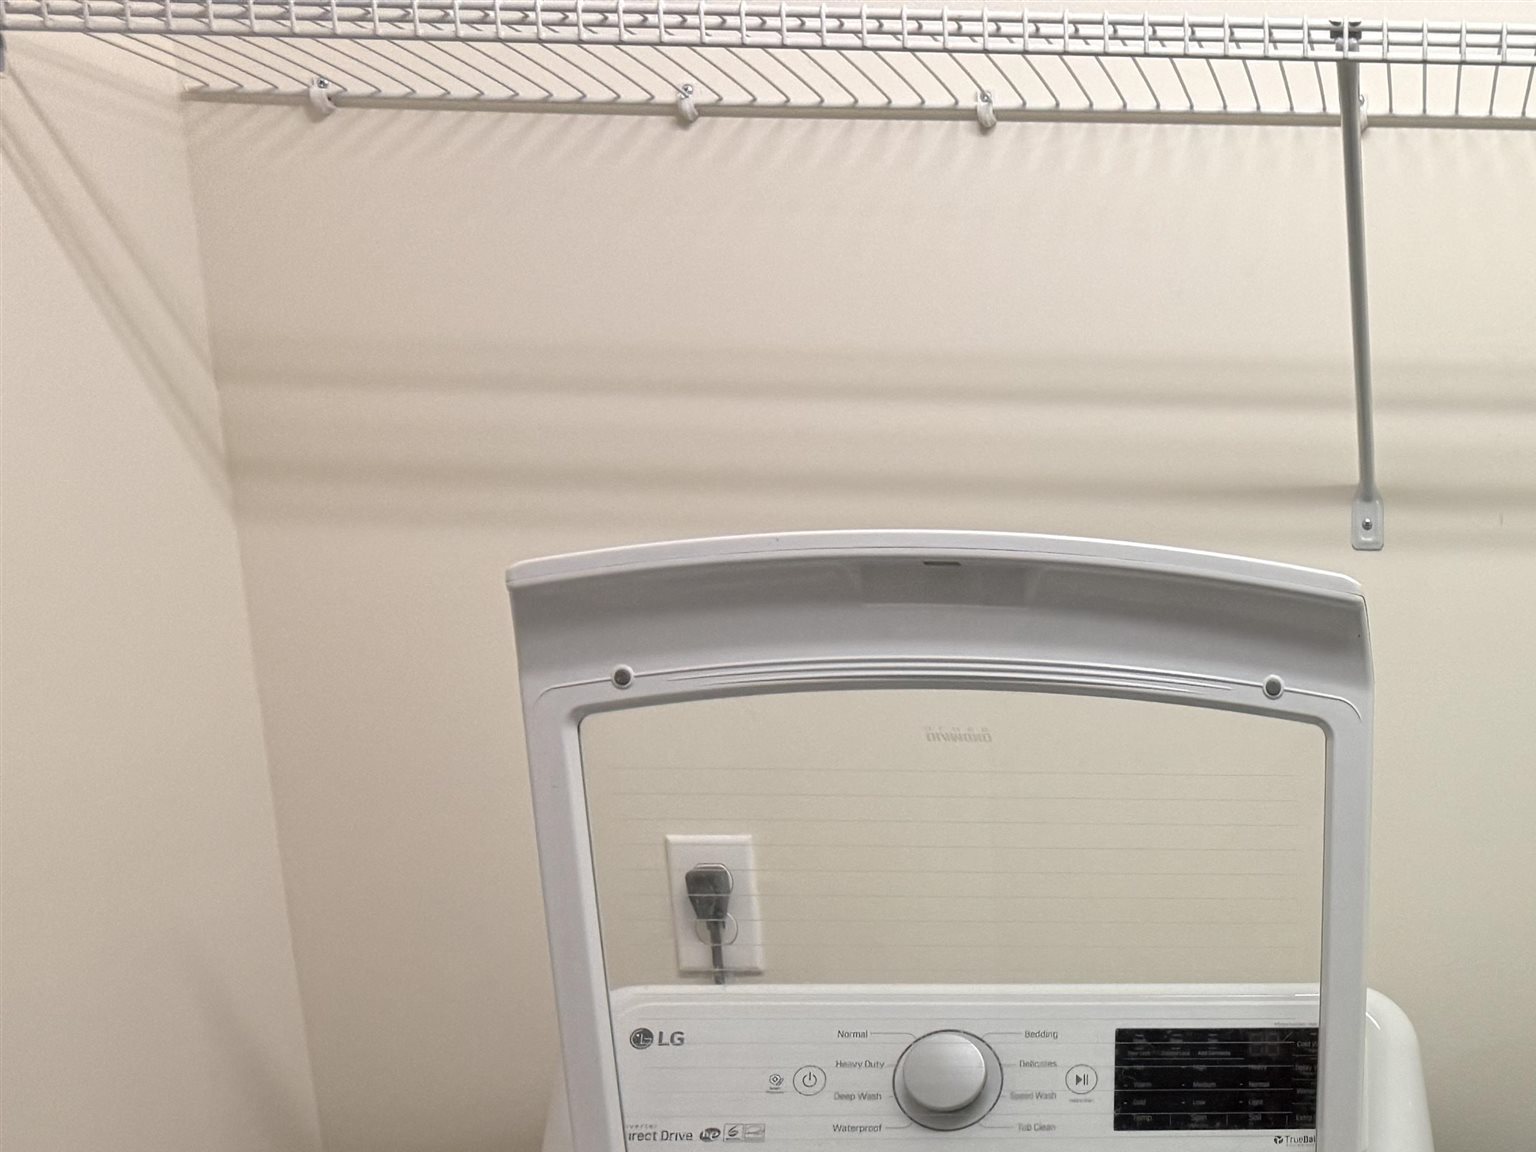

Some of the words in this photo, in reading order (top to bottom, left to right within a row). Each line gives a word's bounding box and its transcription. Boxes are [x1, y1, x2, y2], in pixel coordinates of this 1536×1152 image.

[658, 1031, 685, 1046] LG
[837, 1030, 868, 1038] Normal
[1024, 1030, 1058, 1040] Bedding
[864, 1060, 885, 1068] Duty
[832, 1124, 882, 1133] Waterproof
[661, 1130, 693, 1141] Drive
